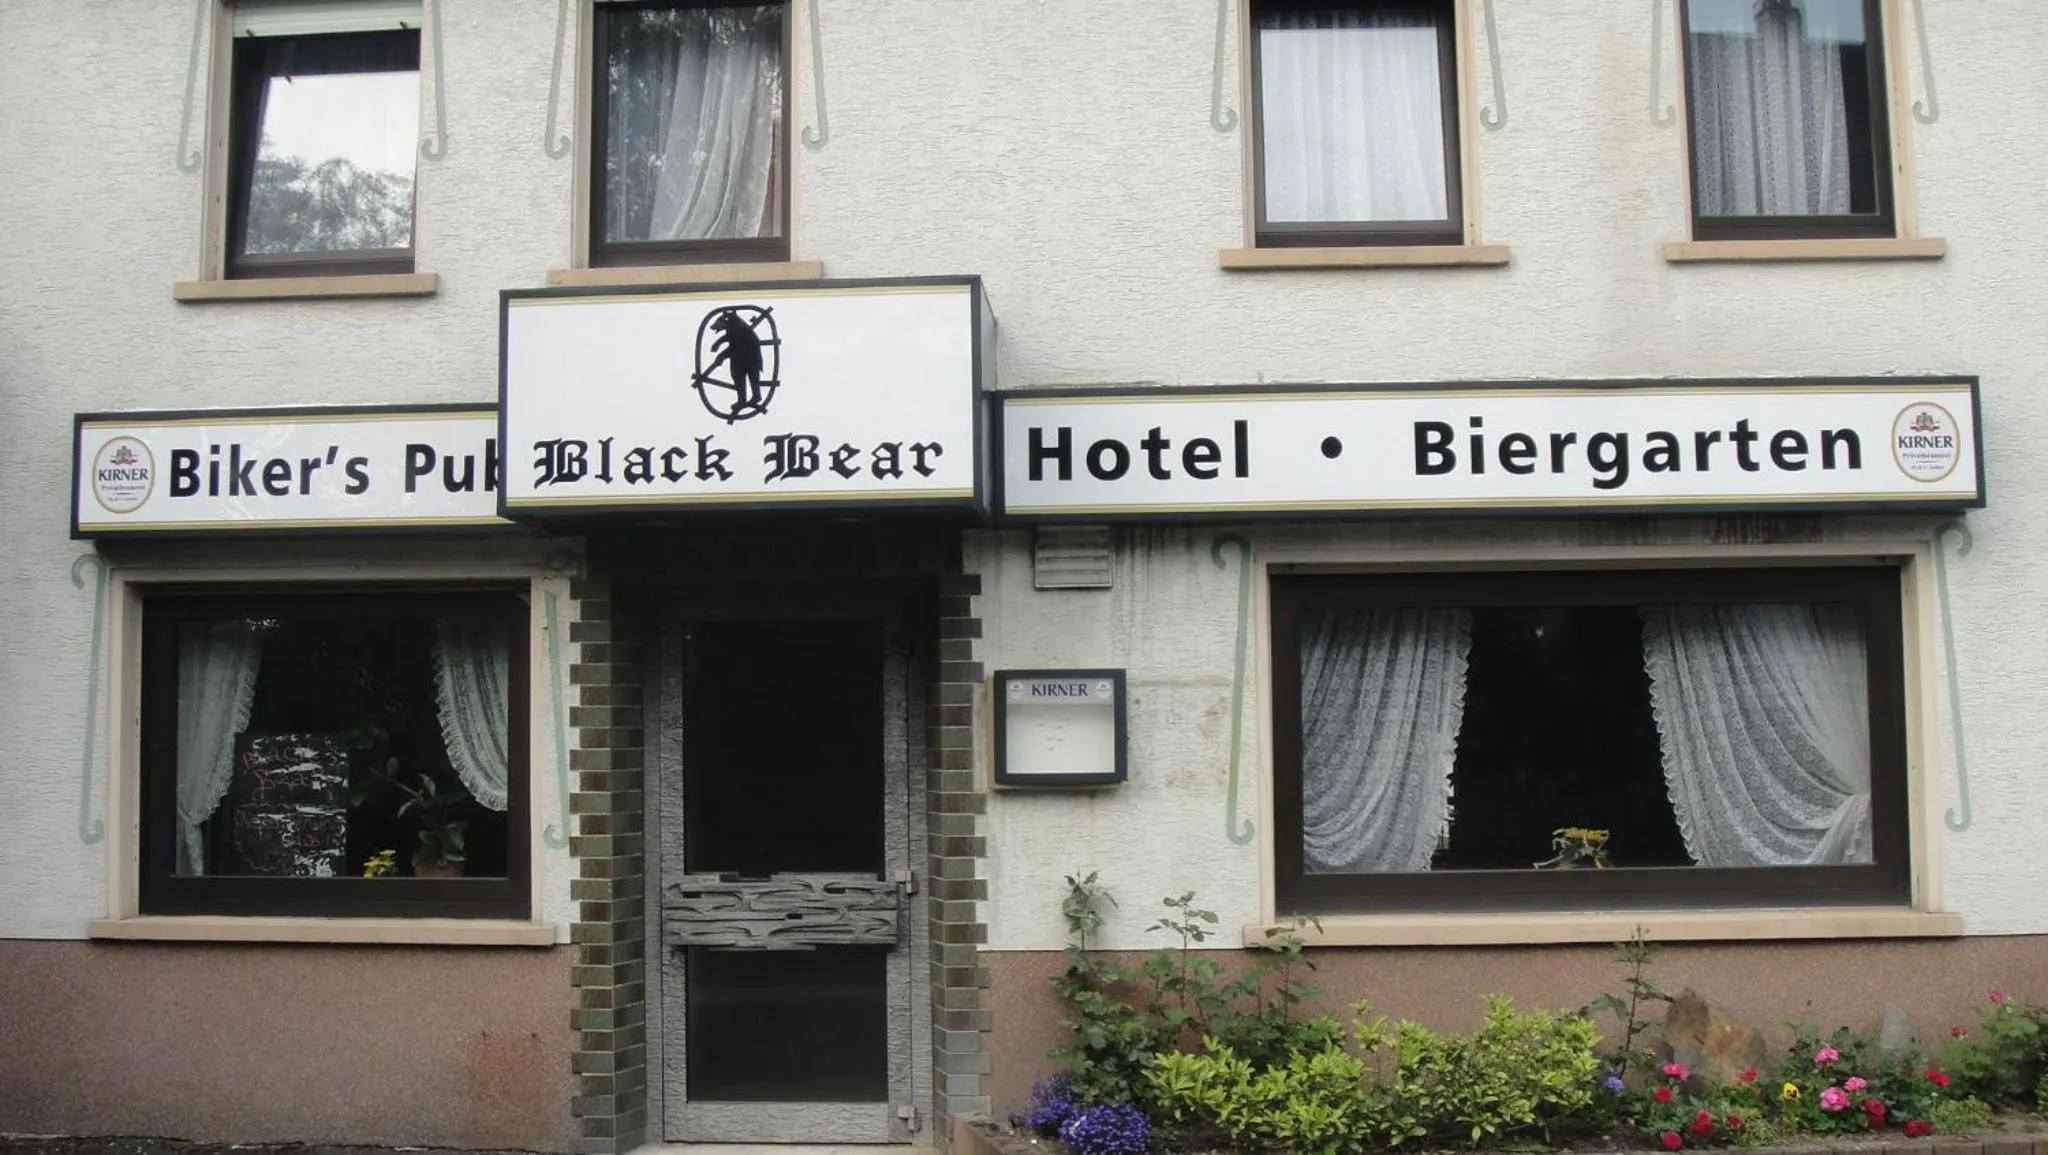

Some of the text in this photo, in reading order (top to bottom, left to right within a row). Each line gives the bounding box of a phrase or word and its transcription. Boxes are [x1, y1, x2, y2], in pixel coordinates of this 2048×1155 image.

[1027, 415, 1863, 490] Hotel Biergarten
[1898, 434, 1954, 449] KIRNER
[98, 468, 149, 481] KIRNER
[169, 443, 370, 498] Biker's
[533, 432, 943, 490] Black Bear
[1031, 683, 1089, 697] KIRNER
